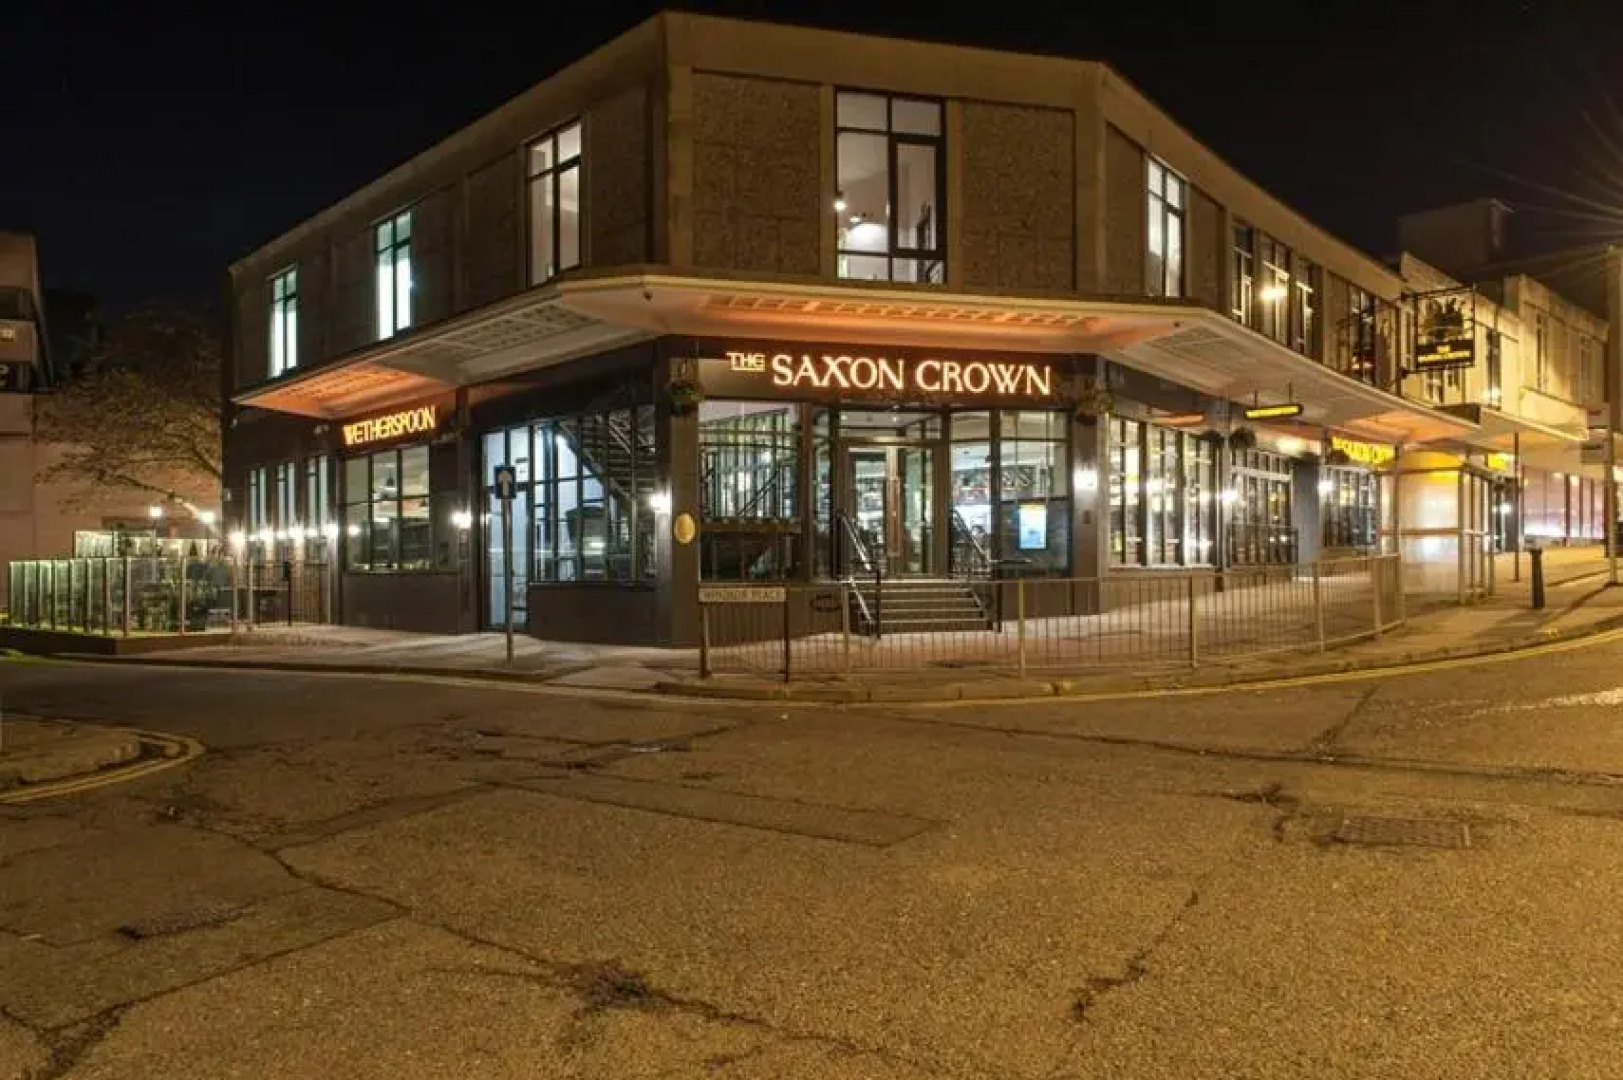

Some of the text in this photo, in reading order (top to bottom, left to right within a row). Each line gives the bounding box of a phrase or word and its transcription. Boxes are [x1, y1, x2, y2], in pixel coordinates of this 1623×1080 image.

[725, 352, 1050, 395] THE SAXON CROWN
[343, 404, 436, 445] WETHERSPOON
